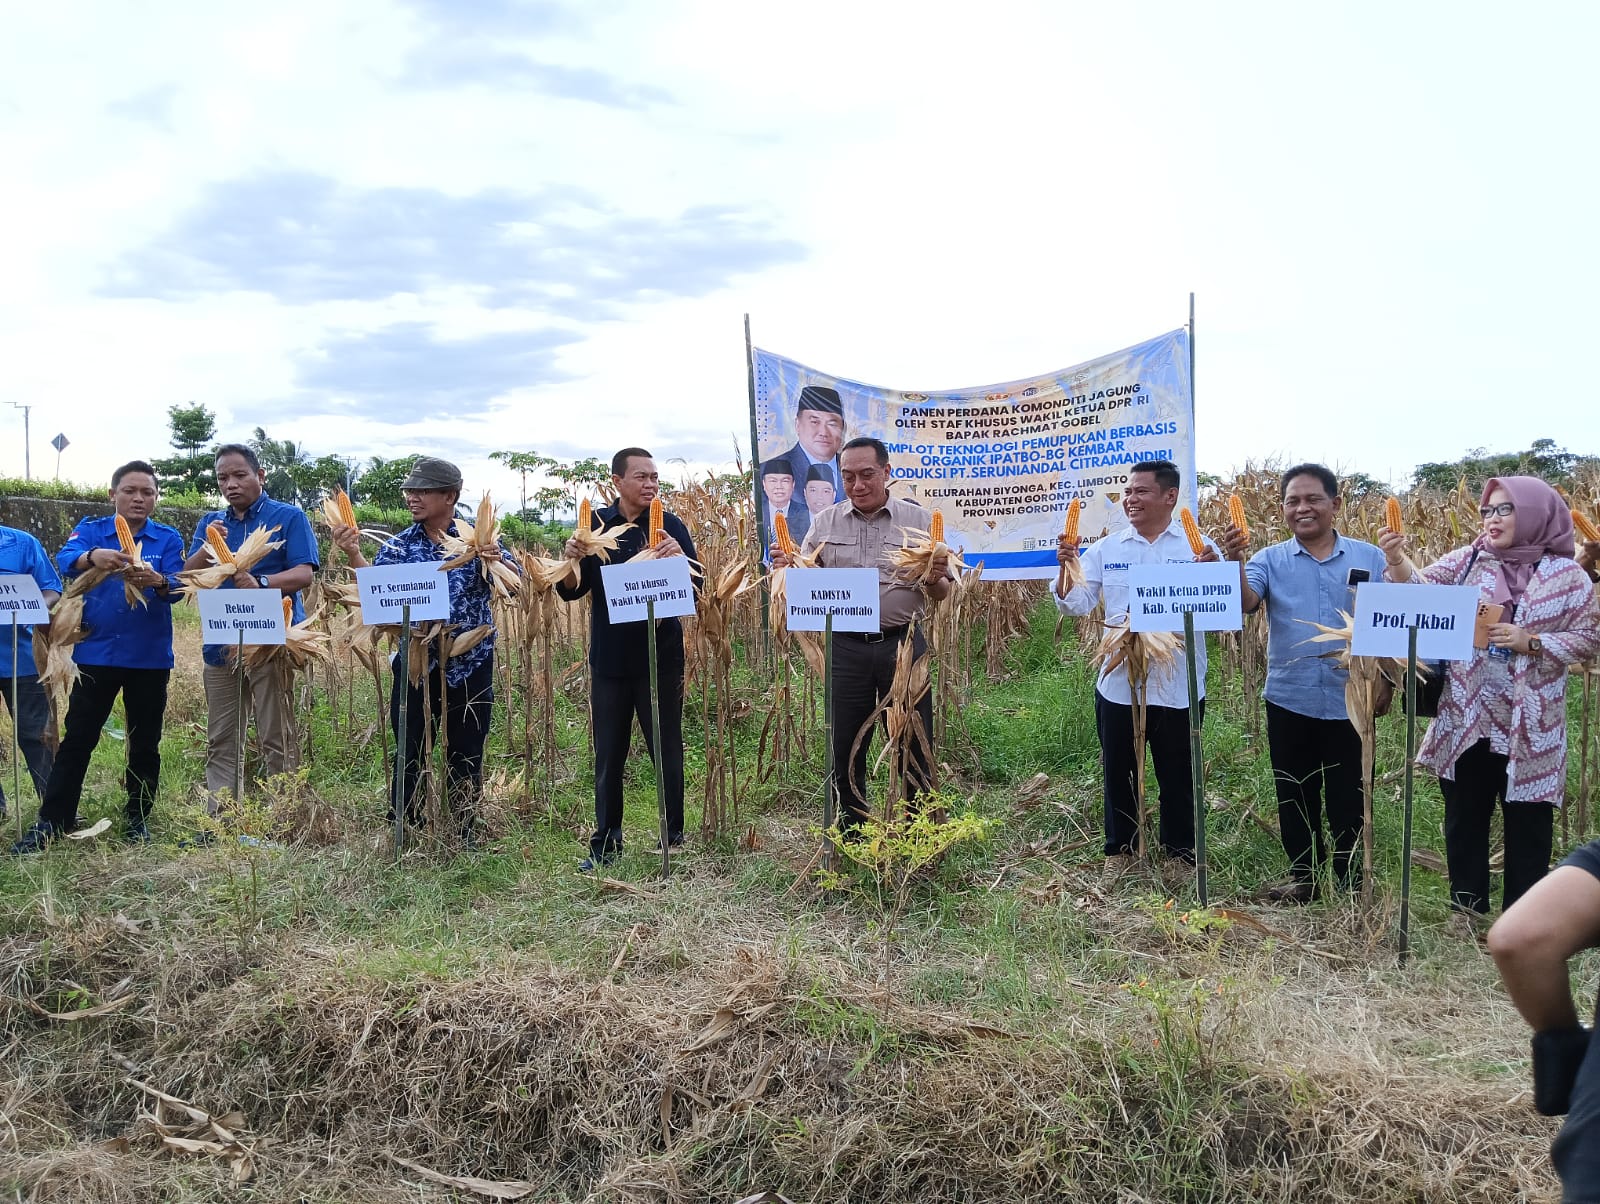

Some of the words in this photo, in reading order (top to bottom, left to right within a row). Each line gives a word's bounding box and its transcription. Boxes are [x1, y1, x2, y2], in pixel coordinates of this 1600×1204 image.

[902, 407, 945, 417] PANEN
[947, 406, 1009, 417] PERDANA
[1012, 395, 1086, 414] KOMONDITI
[1089, 384, 1141, 401] JAGUNG
[895, 419, 926, 429] OLEH
[931, 420, 962, 429] STAF
[965, 417, 1017, 428] KHUSUS
[1020, 411, 1061, 424] WAKIL
[1064, 402, 1106, 417] KETUA
[1108, 398, 1132, 410] DPR
[1137, 395, 1149, 405] RI
[946, 430, 989, 440] BAPAK
[992, 421, 1058, 438] RACHMAT
[1061, 415, 1101, 428] GOBEL
[884, 442, 935, 454] EMPLOT
[938, 442, 1018, 455] TEKNOLOGI
[1022, 430, 1106, 450] PEMUPUKAN
[1110, 422, 1177, 440] BERBASIS
[921, 455, 986, 467] ORGANIK
[990, 448, 1065, 465] IPATBO-BG
[1068, 441, 1125, 458] KEMBAR
[1070, 449, 1173, 470] CITRAMANDIRI
[925, 487, 991, 497] KELURAHAN
[994, 484, 1047, 495] BIYONGA,
[1049, 481, 1075, 490] KEC.
[1077, 475, 1128, 488] LIMBOTO
[955, 498, 1021, 508] KABUPATEN
[1024, 489, 1095, 503] GORONTALO
[963, 507, 1015, 517] PROVINSI
[1018, 501, 1087, 514] GORONTO
[371, 584, 386, 595] PT.
[387, 580, 436, 593] Seruniandal
[624, 582, 639, 592] Staf
[1136, 586, 1166, 598] Wakil
[1169, 585, 1199, 597] Ketua
[1202, 584, 1232, 596] DPRD
[380, 595, 431, 608] Citramandiri
[610, 596, 634, 608] Wakil
[635, 594, 658, 605] Ketua
[659, 590, 677, 602] DPR
[678, 588, 687, 599] RI
[811, 590, 851, 601] KADISTAN
[21, 599, 41, 610] Tani
[225, 603, 255, 614] Rektor
[790, 605, 827, 617] Provinsi
[828, 605, 873, 617] Gorontalo
[1142, 602, 1168, 615] Kab.
[1171, 600, 1227, 614] Gorontalo
[208, 619, 230, 630] Univ.
[232, 618, 276, 630] Gorontalo
[1372, 612, 1409, 629] Prof.
[1415, 613, 1456, 631] Ikbal
